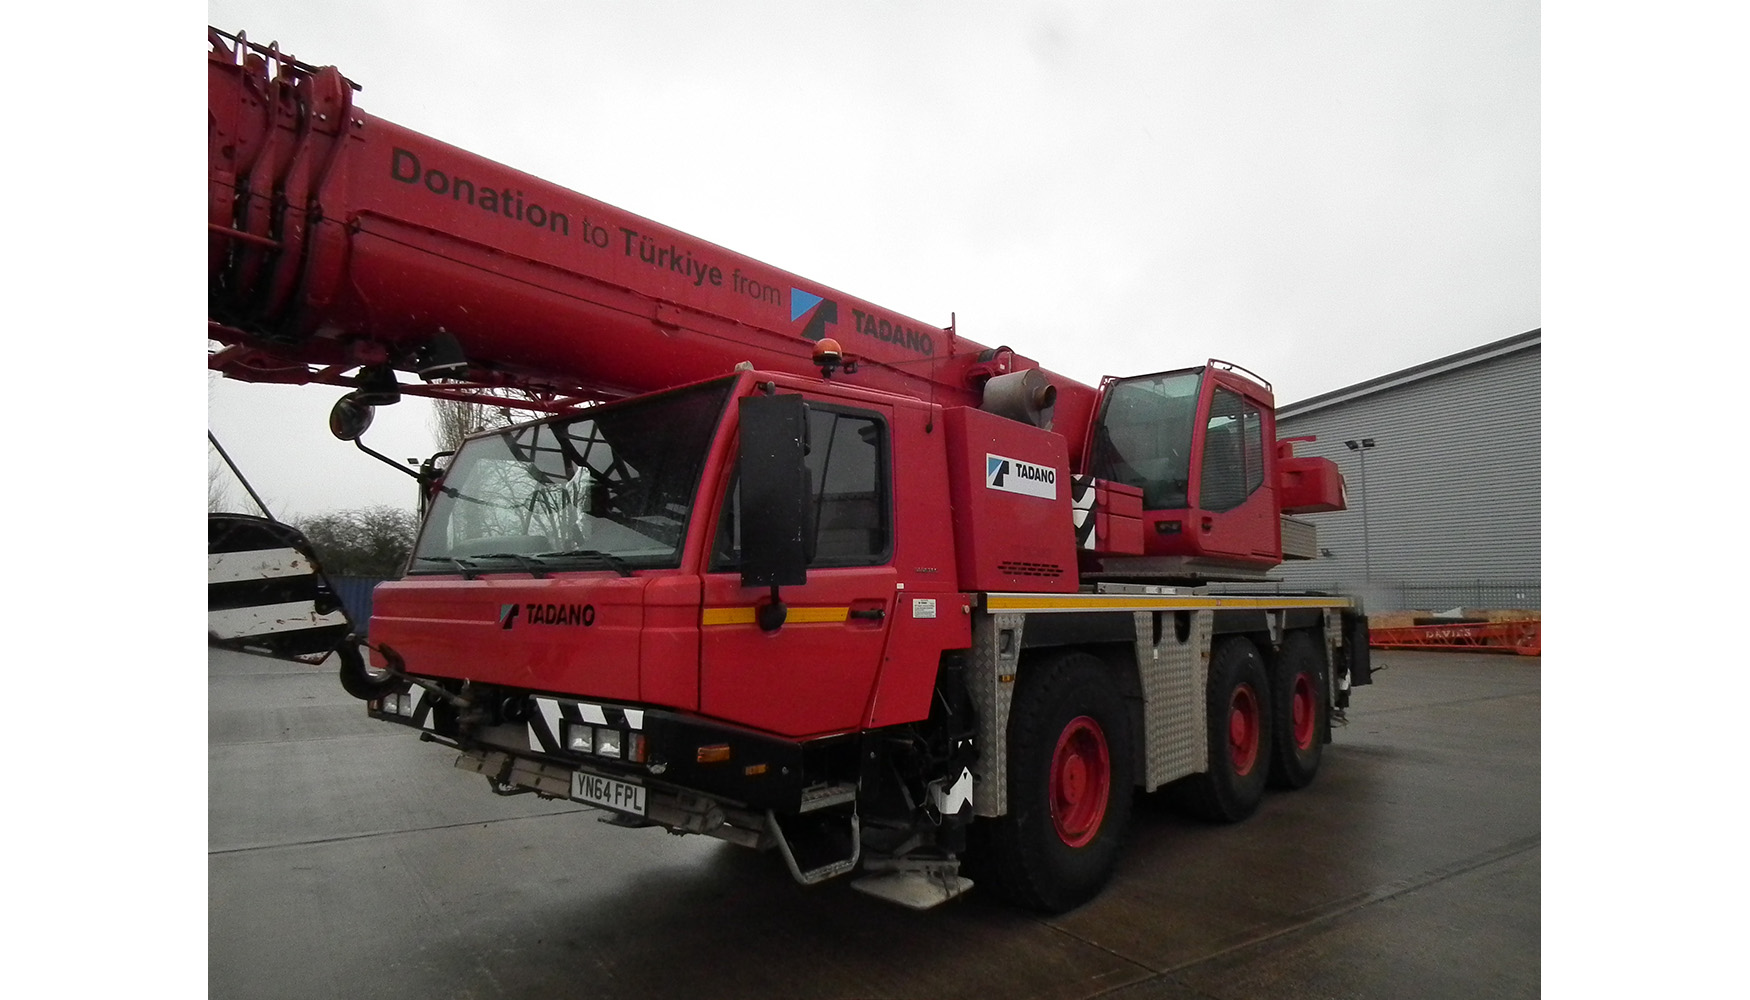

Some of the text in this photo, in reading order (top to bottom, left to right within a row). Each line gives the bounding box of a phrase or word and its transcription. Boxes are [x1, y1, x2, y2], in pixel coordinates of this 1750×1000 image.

[391, 146, 934, 356] Donation to Türkiye from TADANO
[1015, 462, 1055, 485] TADANO
[526, 603, 595, 627] TADANO
[1425, 628, 1472, 639] DAVIES
[578, 774, 642, 811] YN64 FPL
